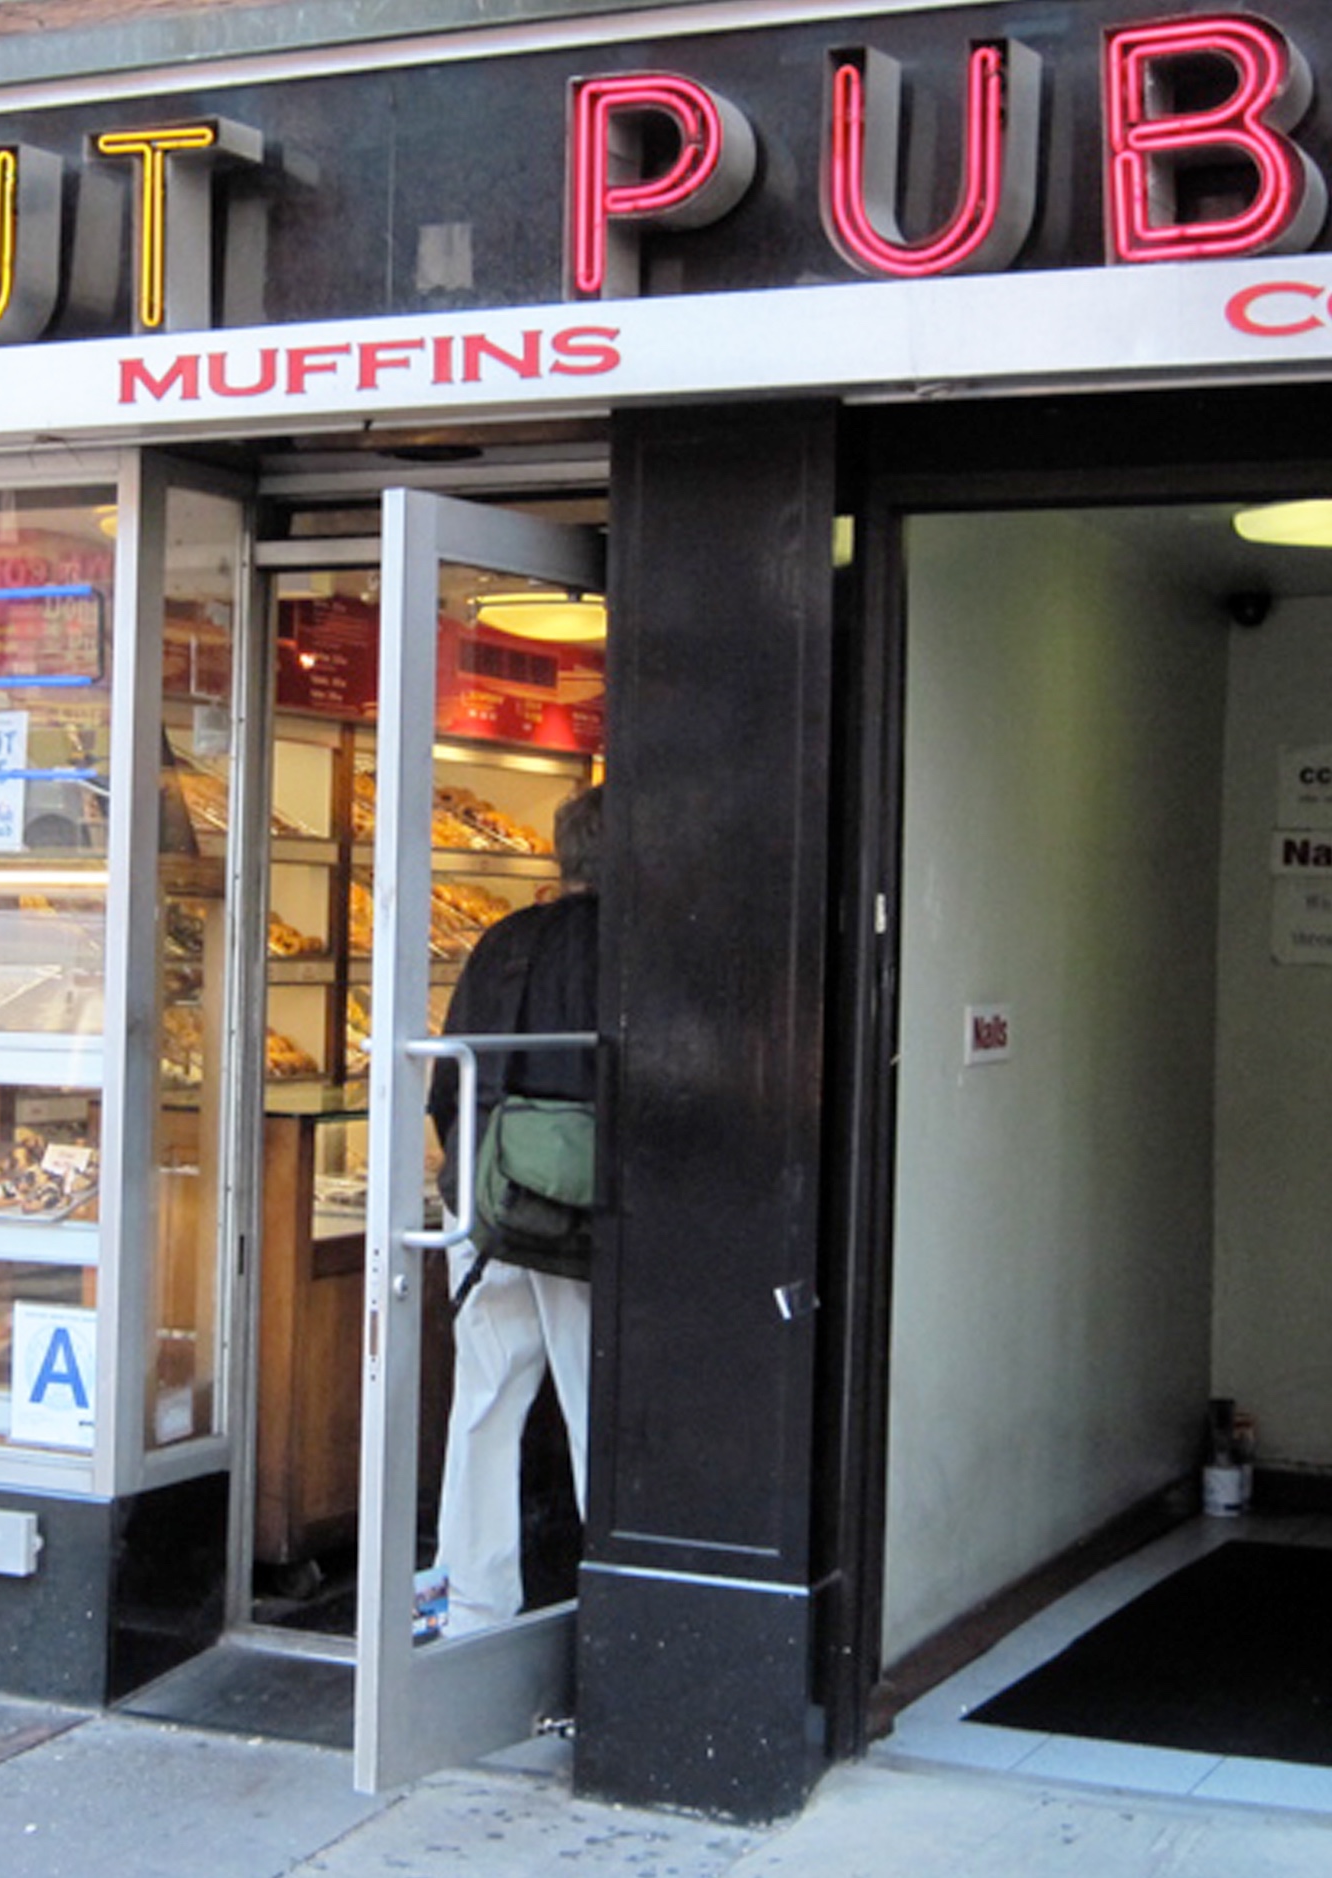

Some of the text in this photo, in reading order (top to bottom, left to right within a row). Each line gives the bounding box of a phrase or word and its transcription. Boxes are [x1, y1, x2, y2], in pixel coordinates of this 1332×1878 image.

[566, 10, 1310, 298] PUB
[1224, 280, 1332, 338] C
[117, 325, 622, 405] MUFFINS
[28, 1327, 90, 1409] A
